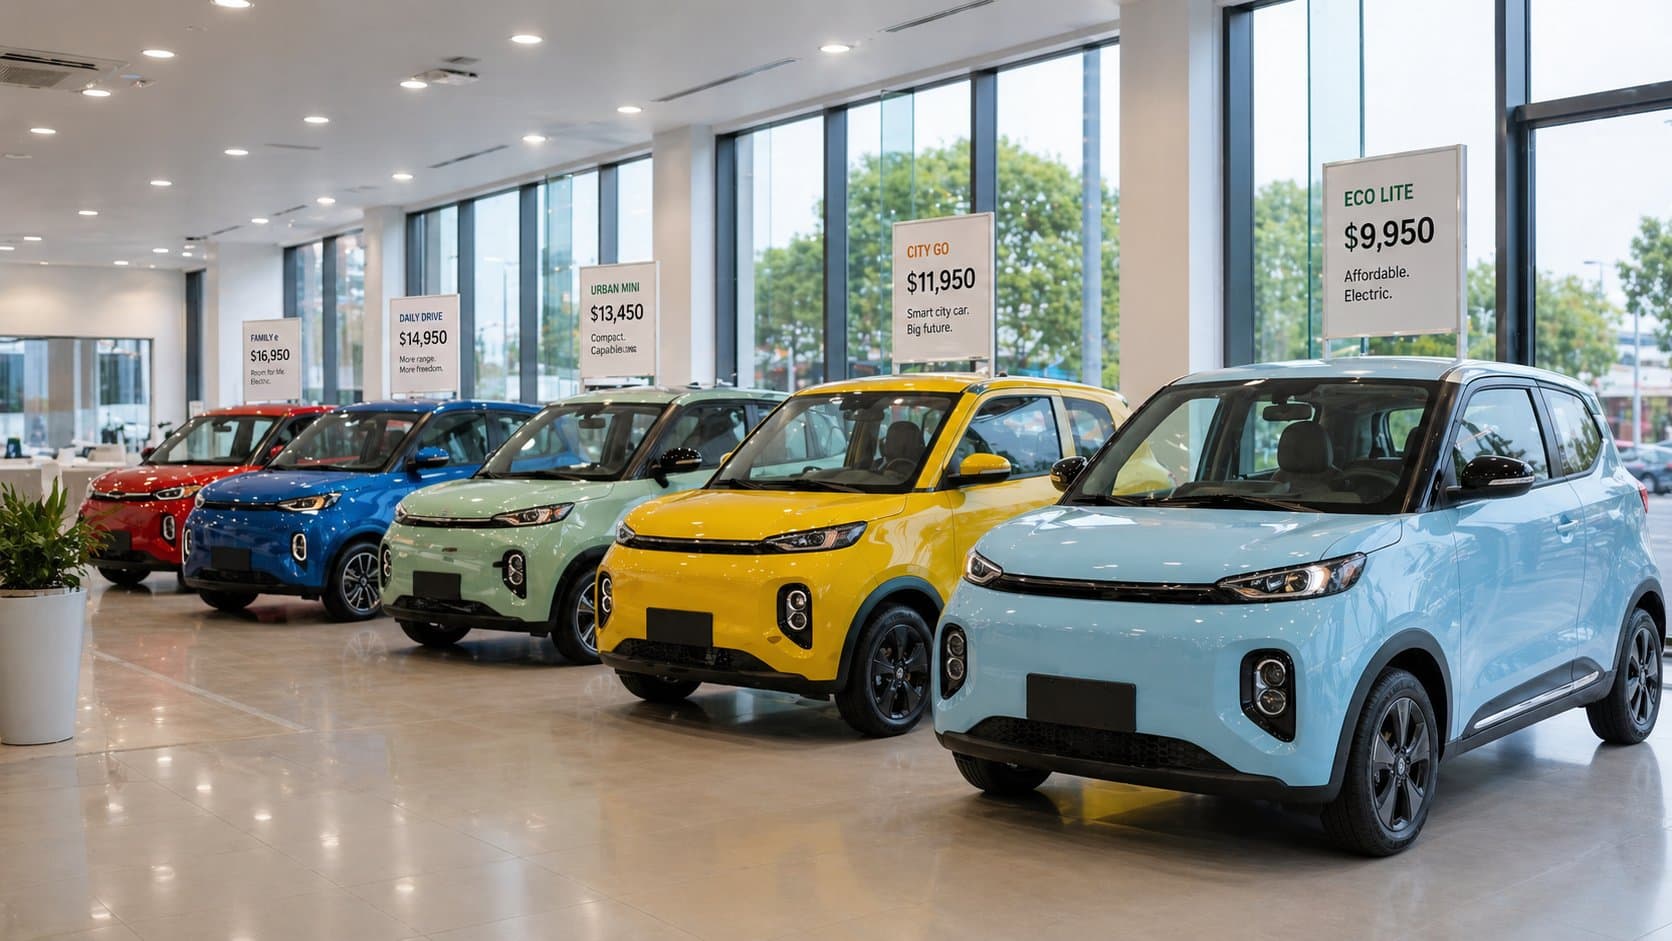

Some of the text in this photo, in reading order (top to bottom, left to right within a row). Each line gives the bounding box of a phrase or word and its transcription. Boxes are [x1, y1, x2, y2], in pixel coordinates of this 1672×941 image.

[1344, 183, 1414, 207] ECO LITE
[1344, 216, 1434, 252] $9,950
[907, 242, 950, 258] CITY GO
[907, 268, 976, 295] $11,950
[1344, 266, 1410, 282] Affordable.
[590, 282, 640, 295] URBAN MINI
[1344, 287, 1392, 302] Electric.
[400, 312, 443, 322] DAILY DRIVE
[590, 304, 644, 325] $13,450
[907, 306, 970, 319] Smart city car.
[907, 322, 952, 337] Big future.
[250, 334, 274, 342] FAMILY
[400, 330, 448, 348] $14,950
[591, 333, 626, 344] Compact.
[250, 348, 290, 363] $16,950
